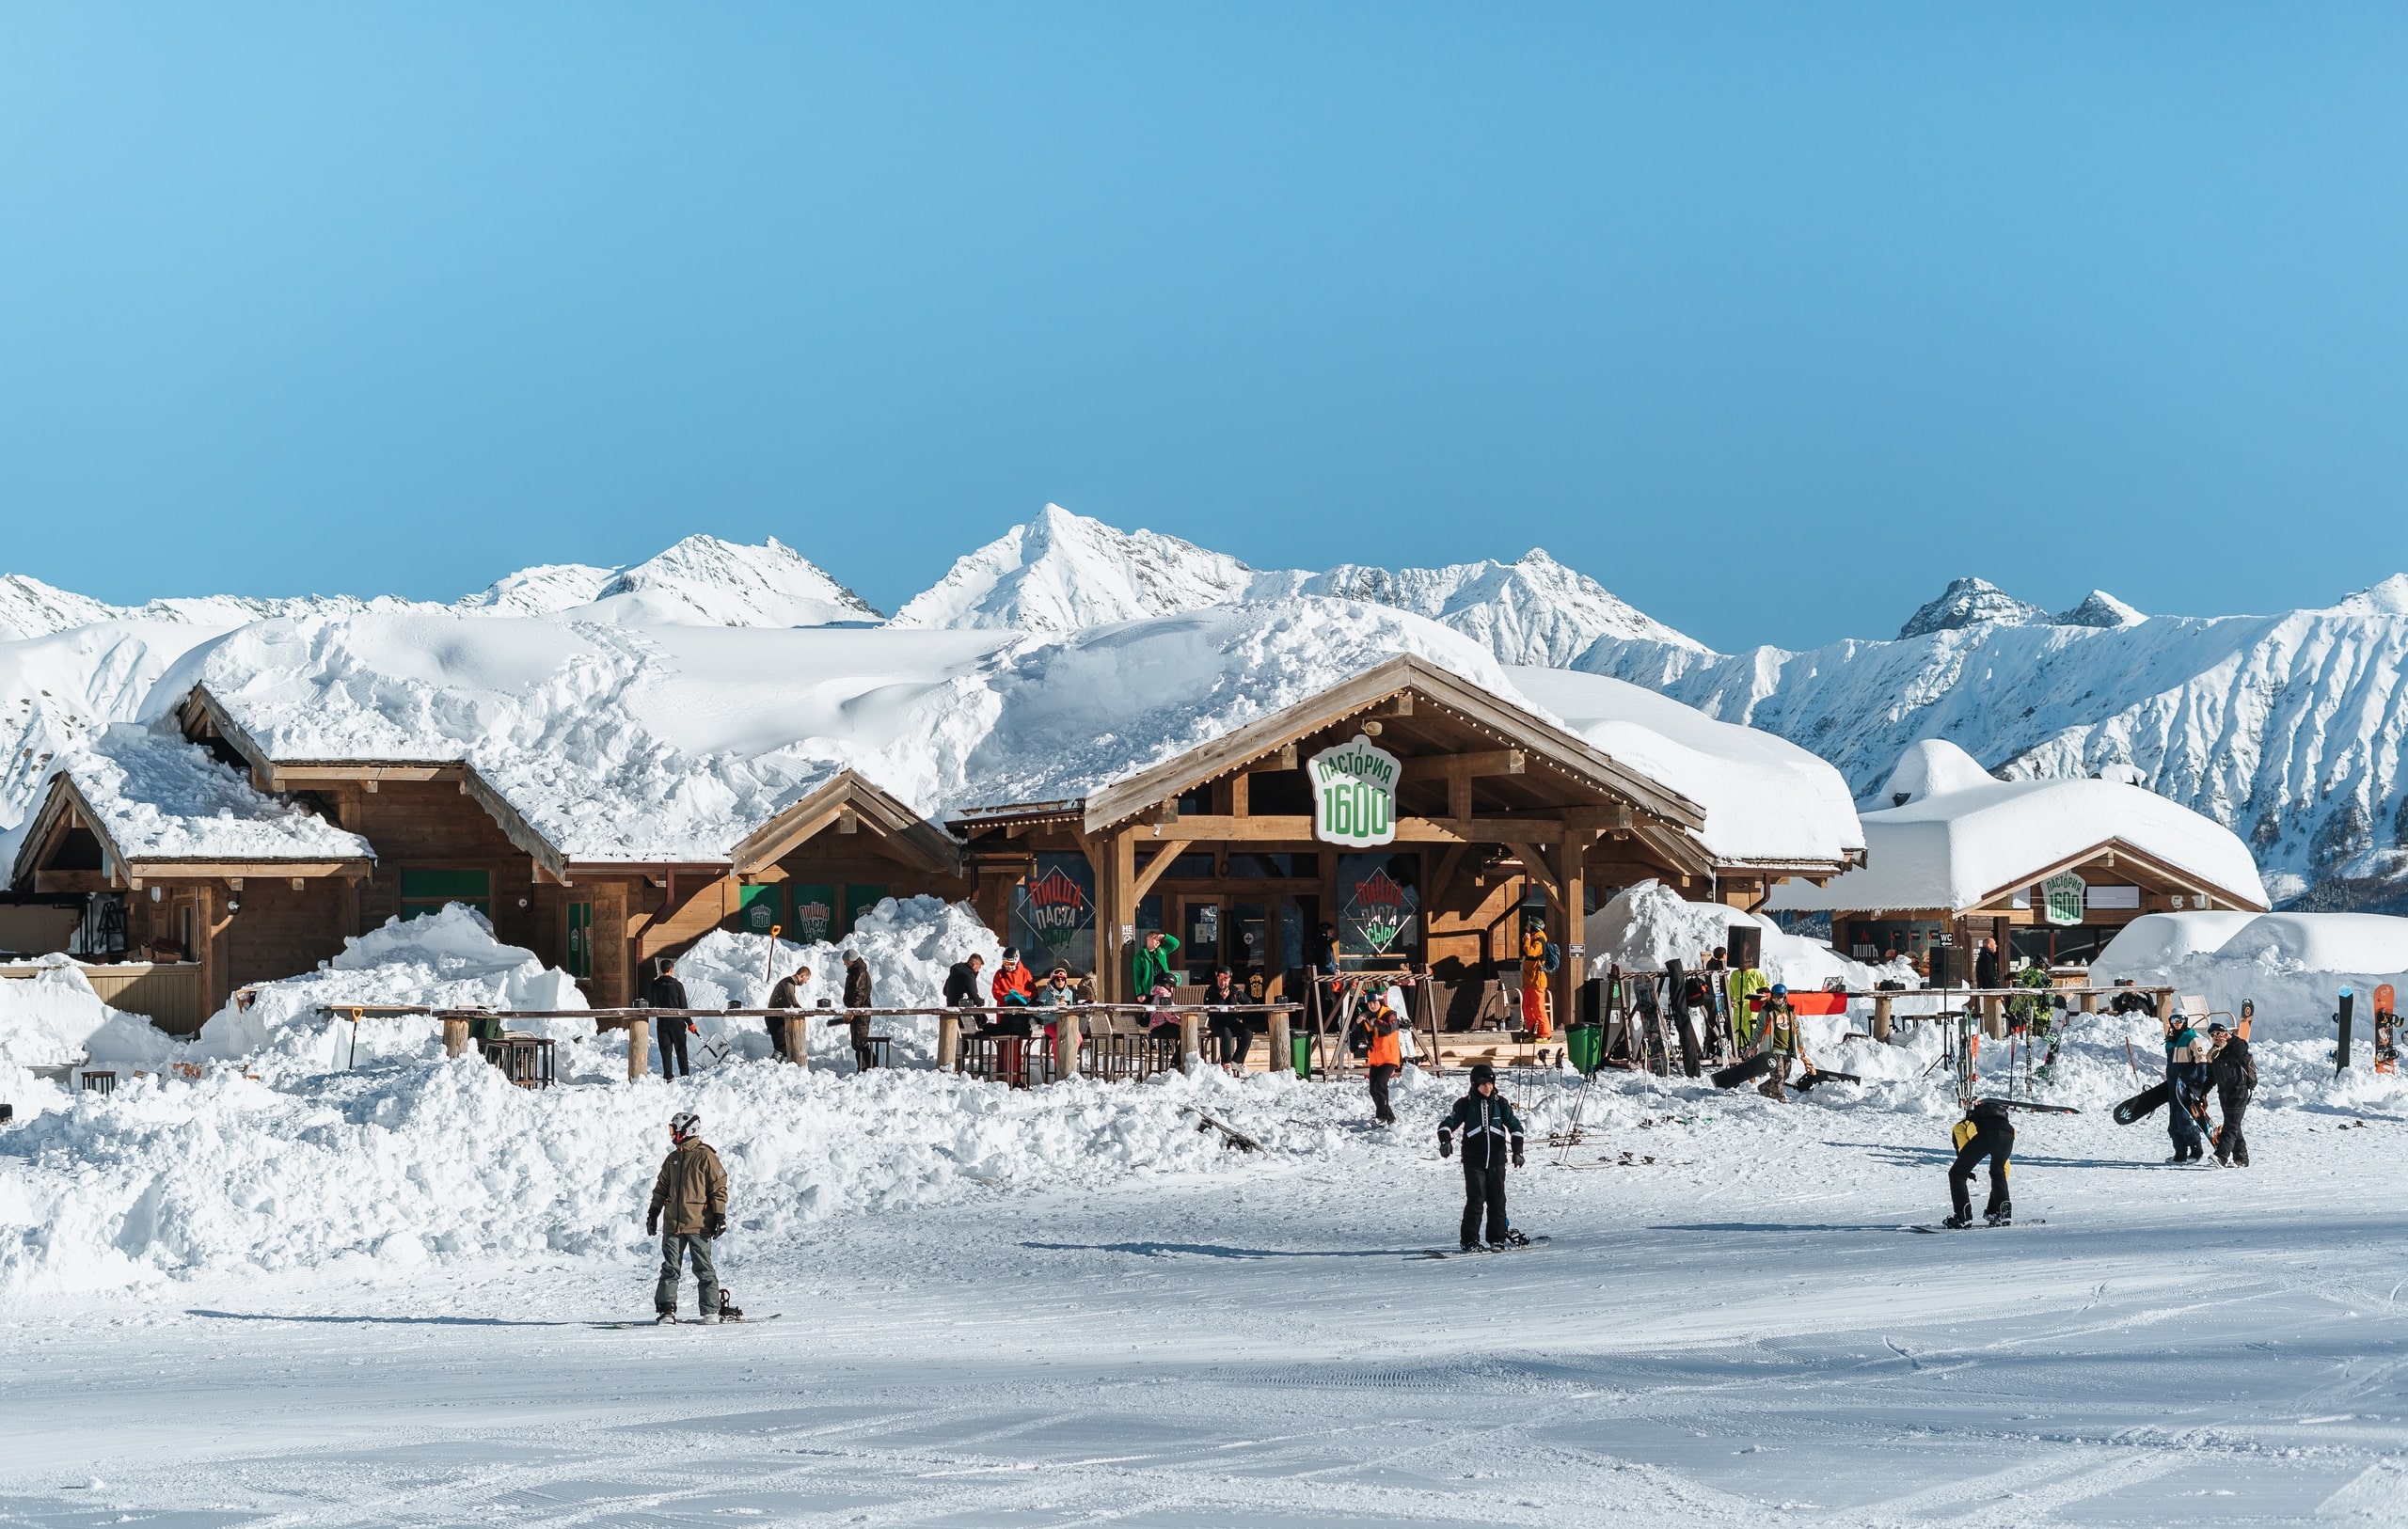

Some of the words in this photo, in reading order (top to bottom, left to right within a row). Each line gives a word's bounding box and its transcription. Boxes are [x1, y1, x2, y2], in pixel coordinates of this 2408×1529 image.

[1323, 782, 1387, 838] 1600
[1029, 875, 1081, 907] ПИЦЦА
[1354, 875, 1402, 906] ПИЦЦА
[800, 902, 829, 921] ПИЦЦА
[1035, 905, 1076, 929] ПАСТА
[1361, 905, 1397, 928] ПАСТА
[2050, 891, 2081, 921] 1600
[752, 913, 769, 926] 1600
[802, 919, 827, 933] ПАСТА
[1366, 922, 1397, 947] СЫР!
[1941, 933, 1953, 941] WC
